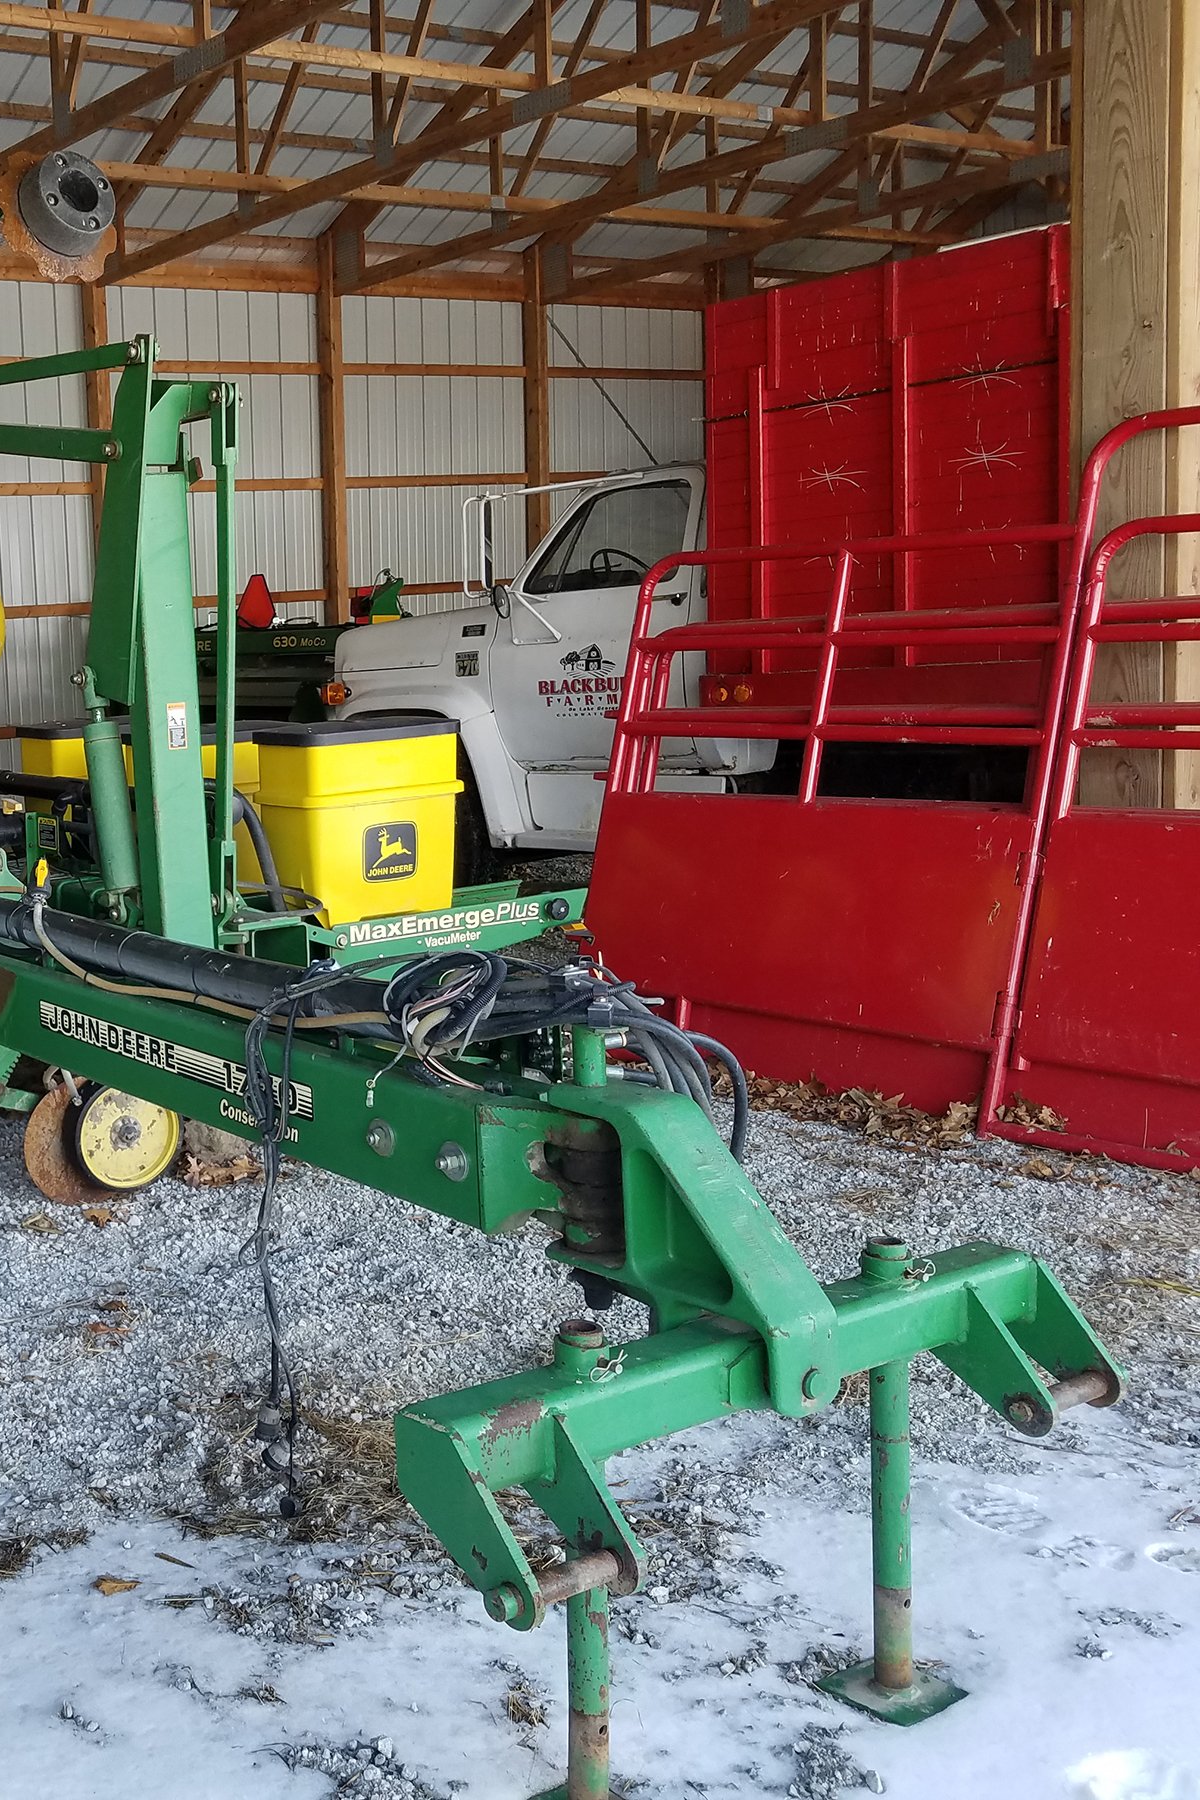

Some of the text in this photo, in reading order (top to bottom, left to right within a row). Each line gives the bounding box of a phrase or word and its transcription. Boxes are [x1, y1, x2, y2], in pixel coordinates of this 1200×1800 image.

[272, 636, 326, 647] 630 MoCo
[456, 660, 480, 676] C70
[538, 676, 625, 695] BLACKBU
[367, 863, 414, 877] JOHN DEERE
[424, 930, 482, 948] VacuMeter
[49, 1005, 300, 1115] JOHN DEERE 170
